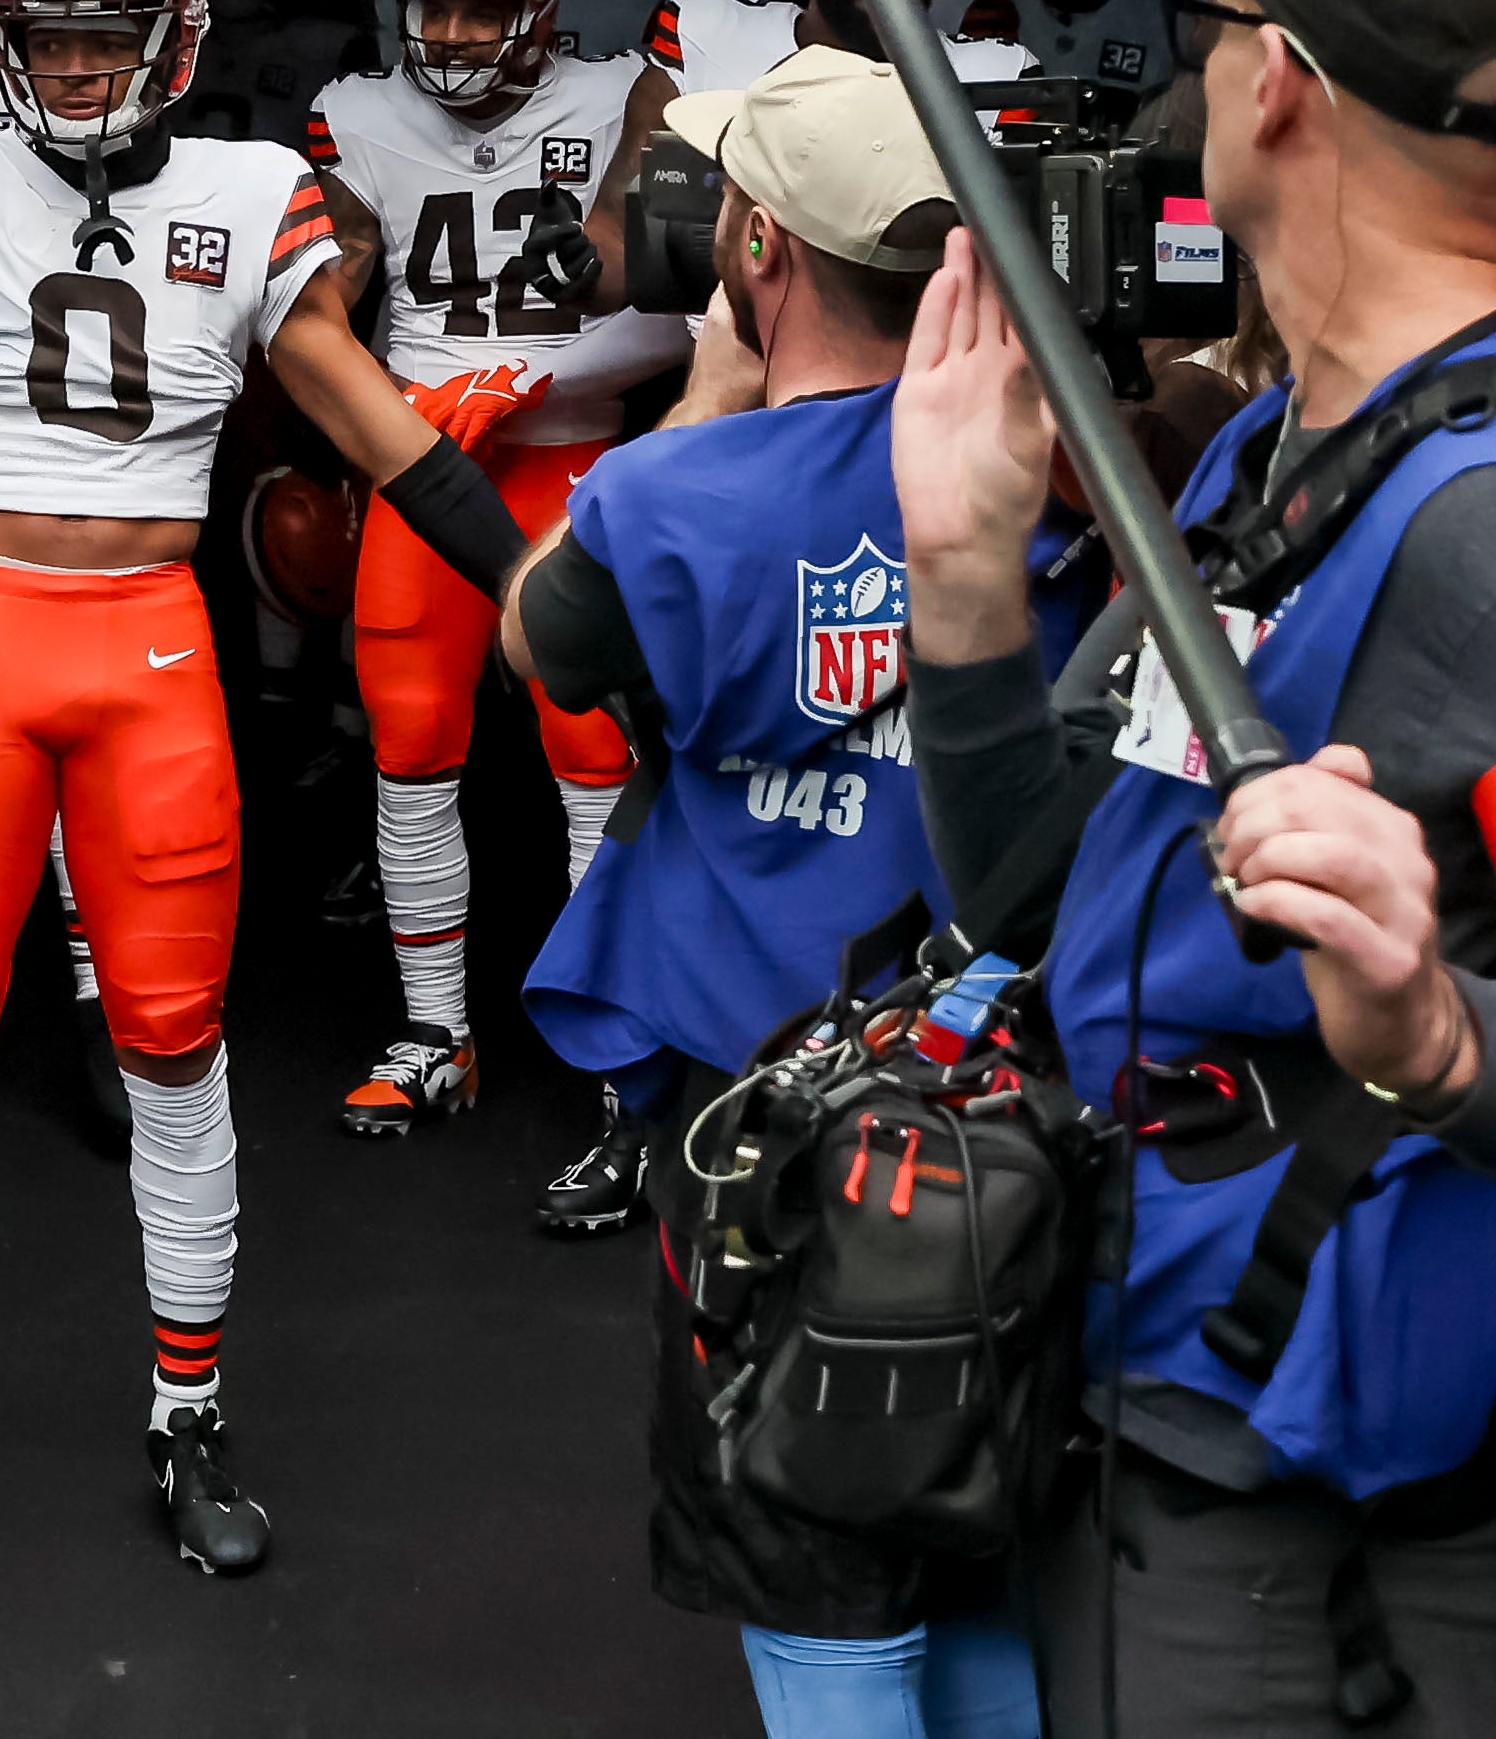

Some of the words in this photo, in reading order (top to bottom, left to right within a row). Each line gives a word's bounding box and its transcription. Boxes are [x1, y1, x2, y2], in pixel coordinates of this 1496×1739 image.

[1103, 43, 1143, 74] 32
[545, 141, 587, 173] 32
[170, 227, 226, 274] 32
[405, 186, 585, 338] 42
[1051, 214, 1070, 284] ARRI
[24, 271, 155, 444] 0
[814, 628, 906, 711] NF
